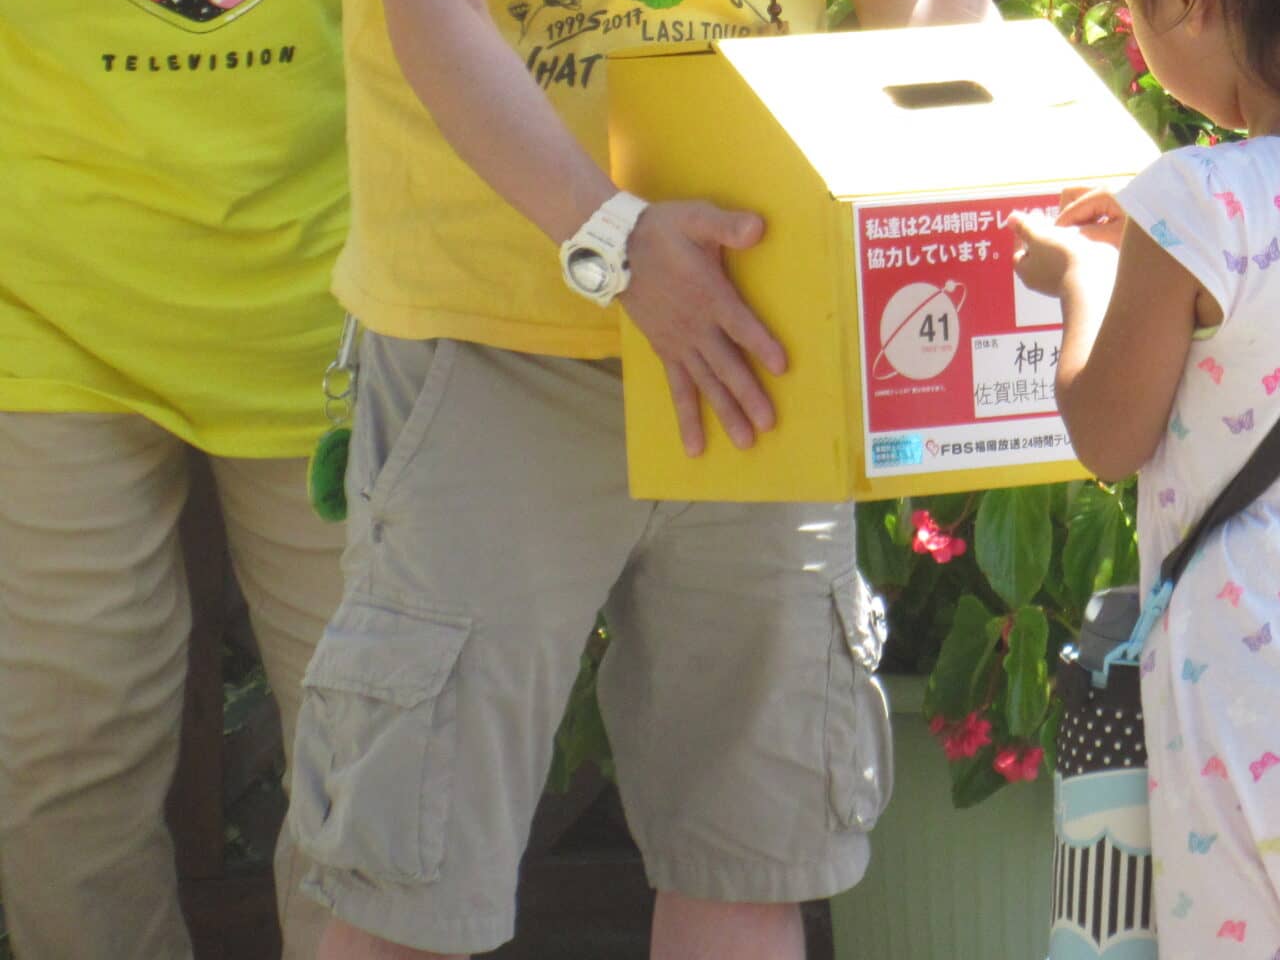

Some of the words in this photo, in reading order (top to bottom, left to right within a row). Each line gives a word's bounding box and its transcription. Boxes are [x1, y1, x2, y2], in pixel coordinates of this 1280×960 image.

[101, 45, 296, 73] TELEVISION
[867, 240, 1000, 270] 協力しています。
[919, 312, 950, 343] 41
